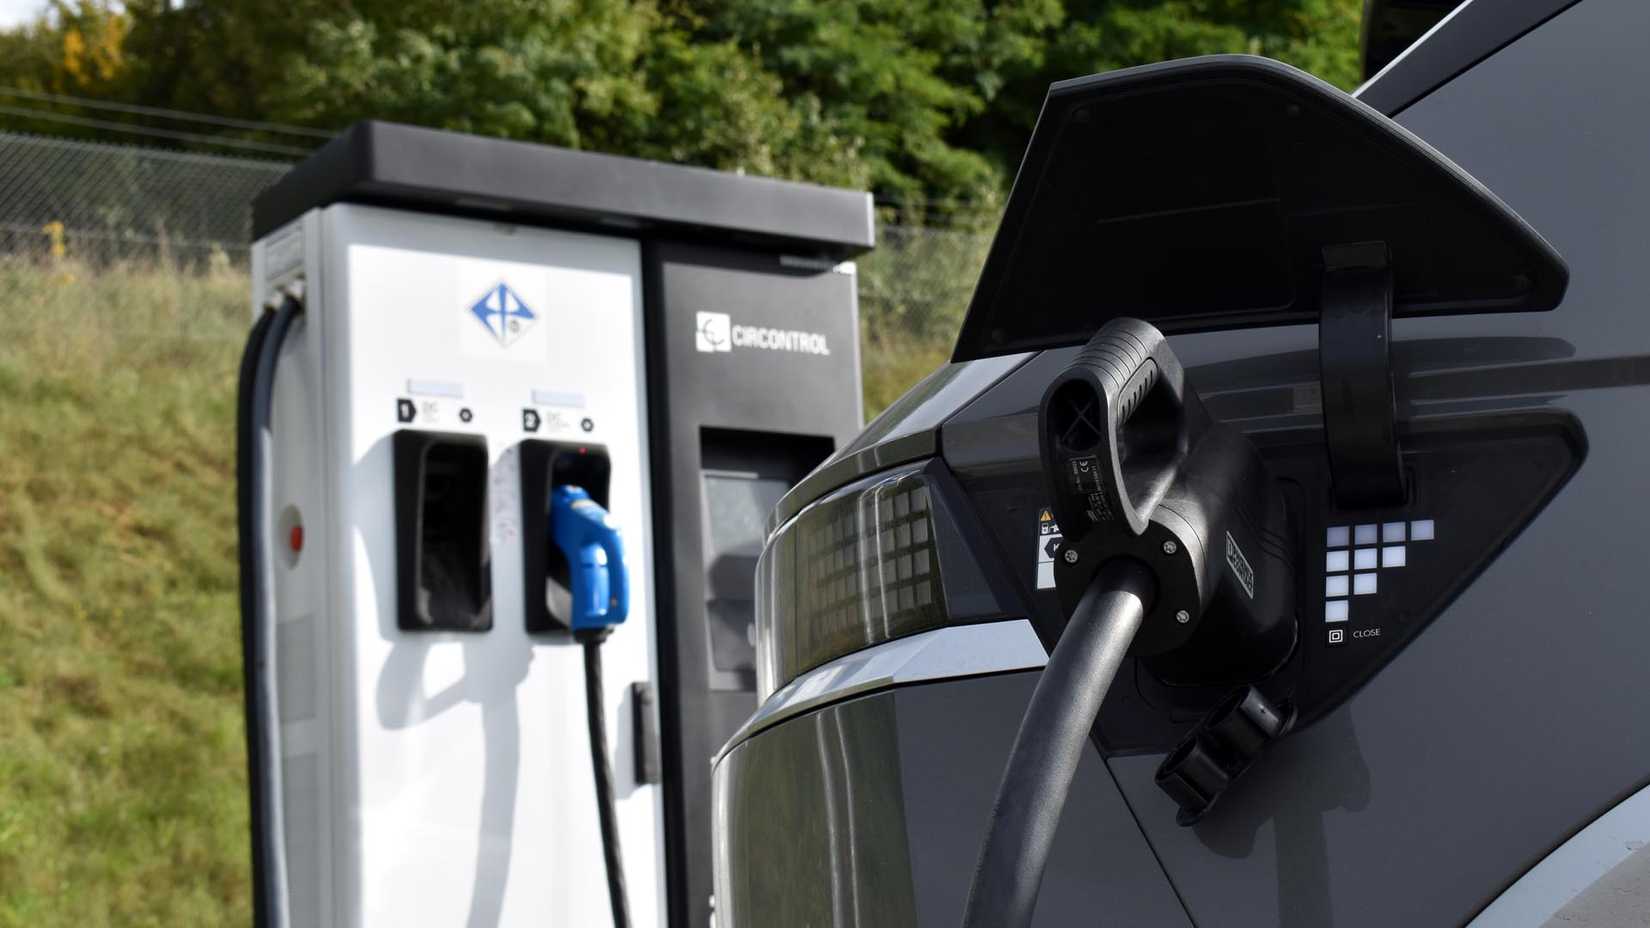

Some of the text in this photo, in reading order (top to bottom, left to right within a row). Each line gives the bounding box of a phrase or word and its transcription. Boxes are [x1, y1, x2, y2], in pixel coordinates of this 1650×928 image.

[731, 324, 831, 356] CIRCONTROL
[1079, 460, 1089, 473] CE
[1352, 628, 1381, 638] CLOSE
